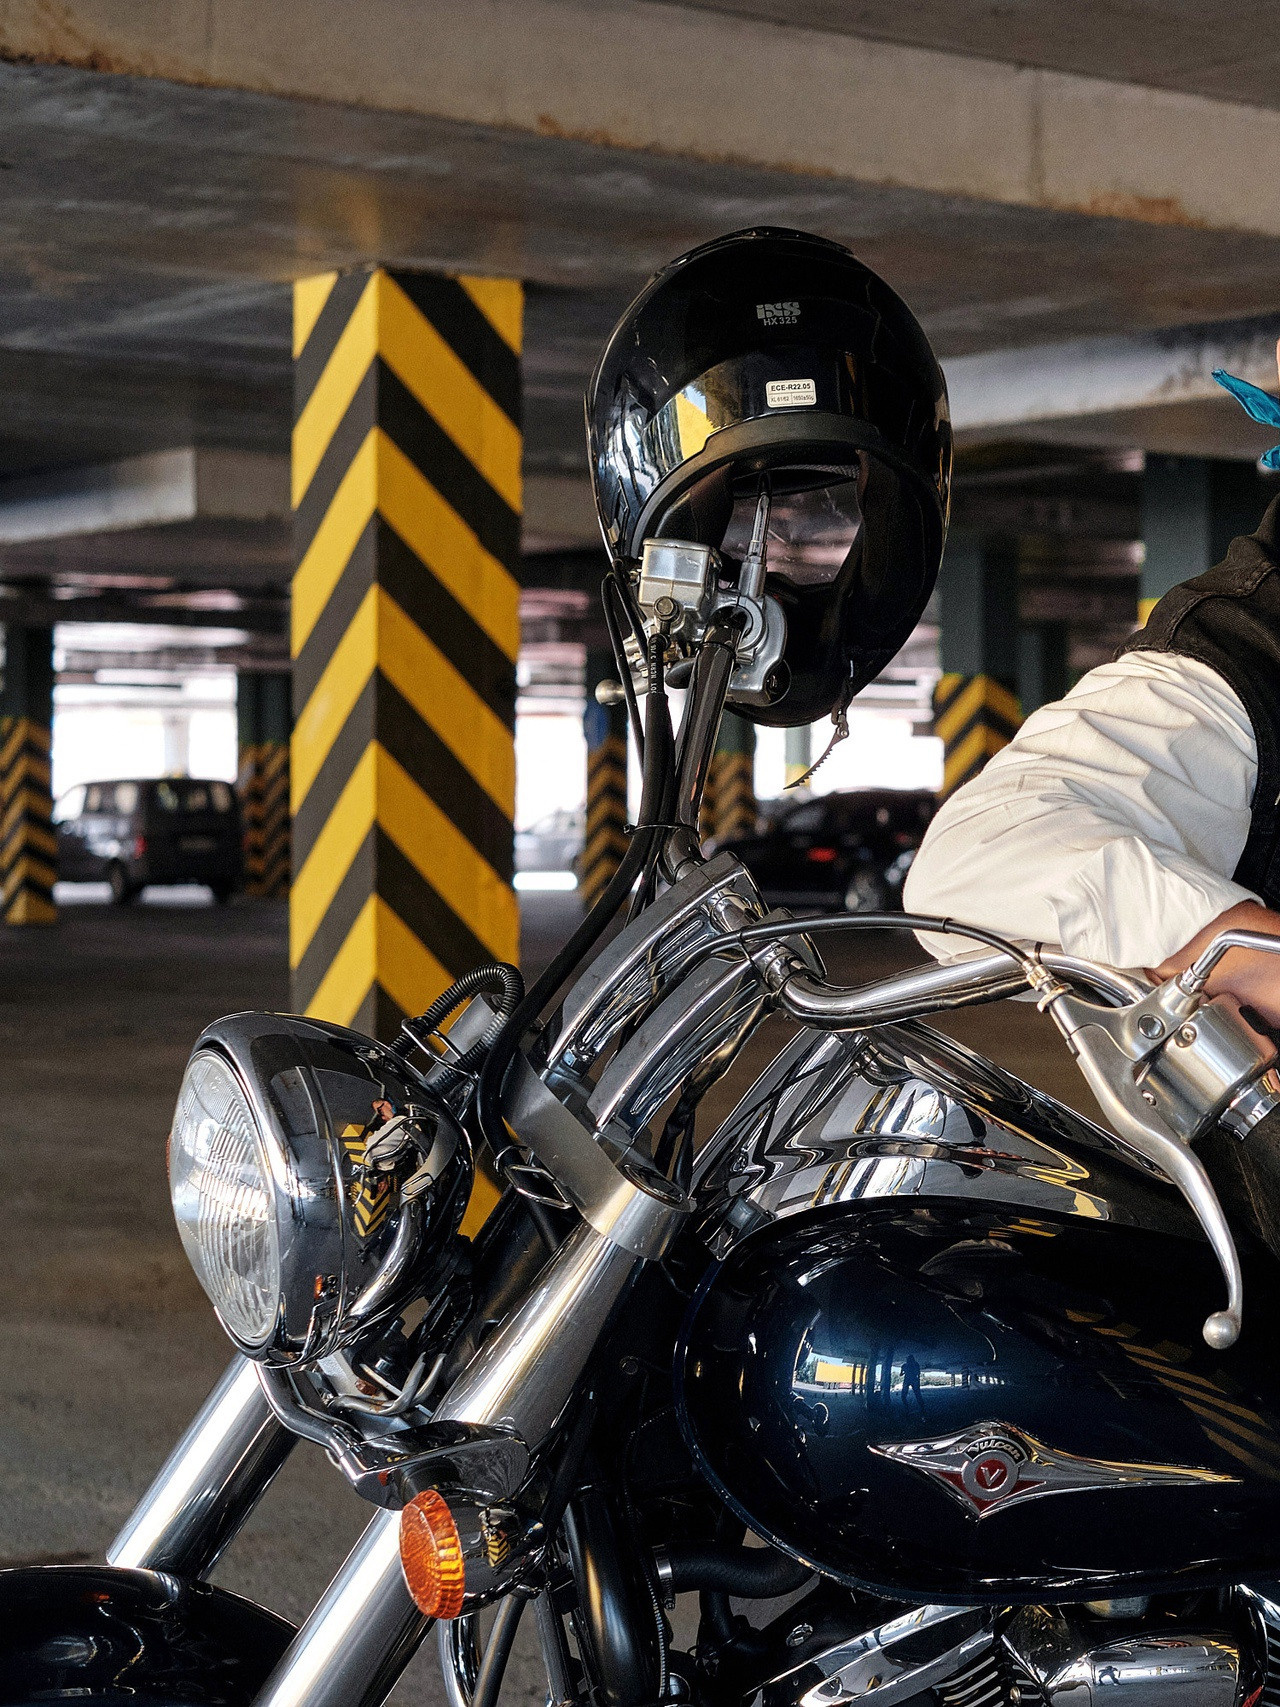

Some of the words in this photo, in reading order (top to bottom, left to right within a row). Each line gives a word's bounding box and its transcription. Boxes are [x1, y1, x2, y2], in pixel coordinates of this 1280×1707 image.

[771, 383, 811, 391] ECE-R22.05
[968, 1440, 1020, 1460] Vulcan
[981, 1466, 1004, 1486] V
